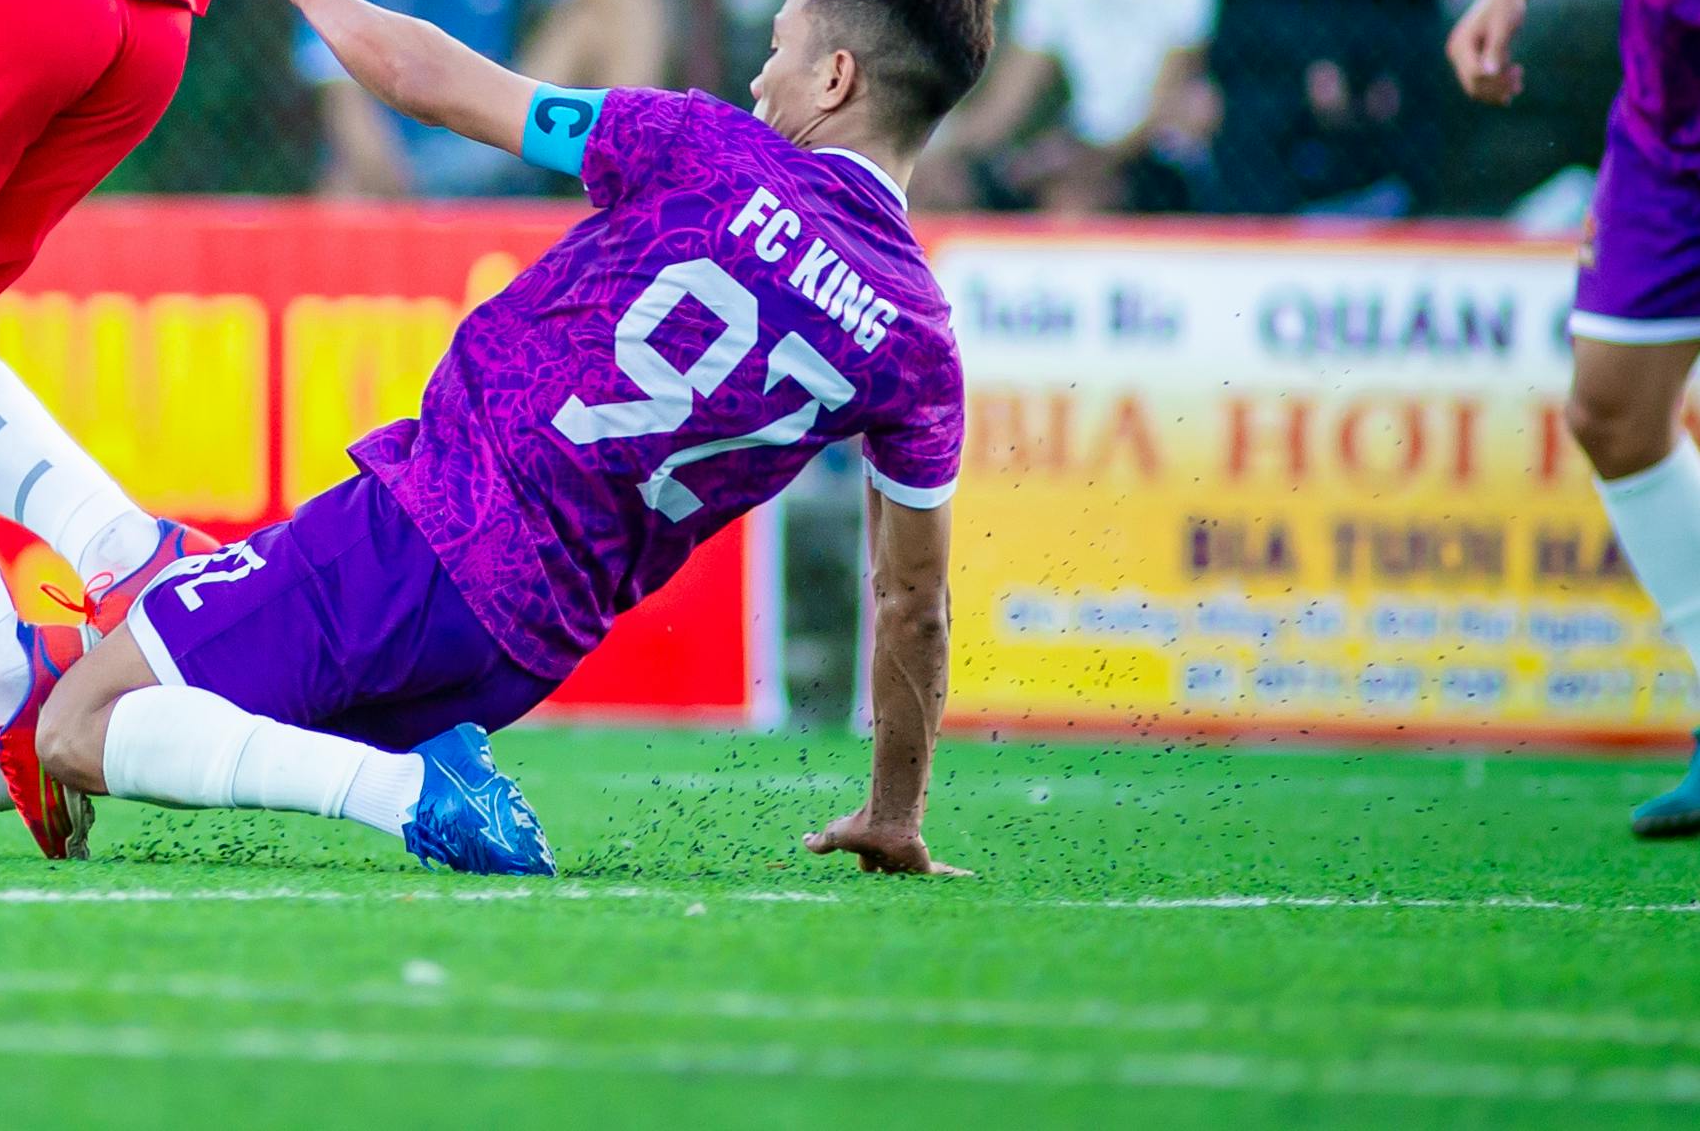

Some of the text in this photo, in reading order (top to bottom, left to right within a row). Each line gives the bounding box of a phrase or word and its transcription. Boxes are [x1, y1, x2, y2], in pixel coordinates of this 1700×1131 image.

[533, 96, 594, 139] C
[727, 186, 900, 354] FC KING
[550, 257, 858, 524] 97
[968, 392, 1164, 480] BIA
